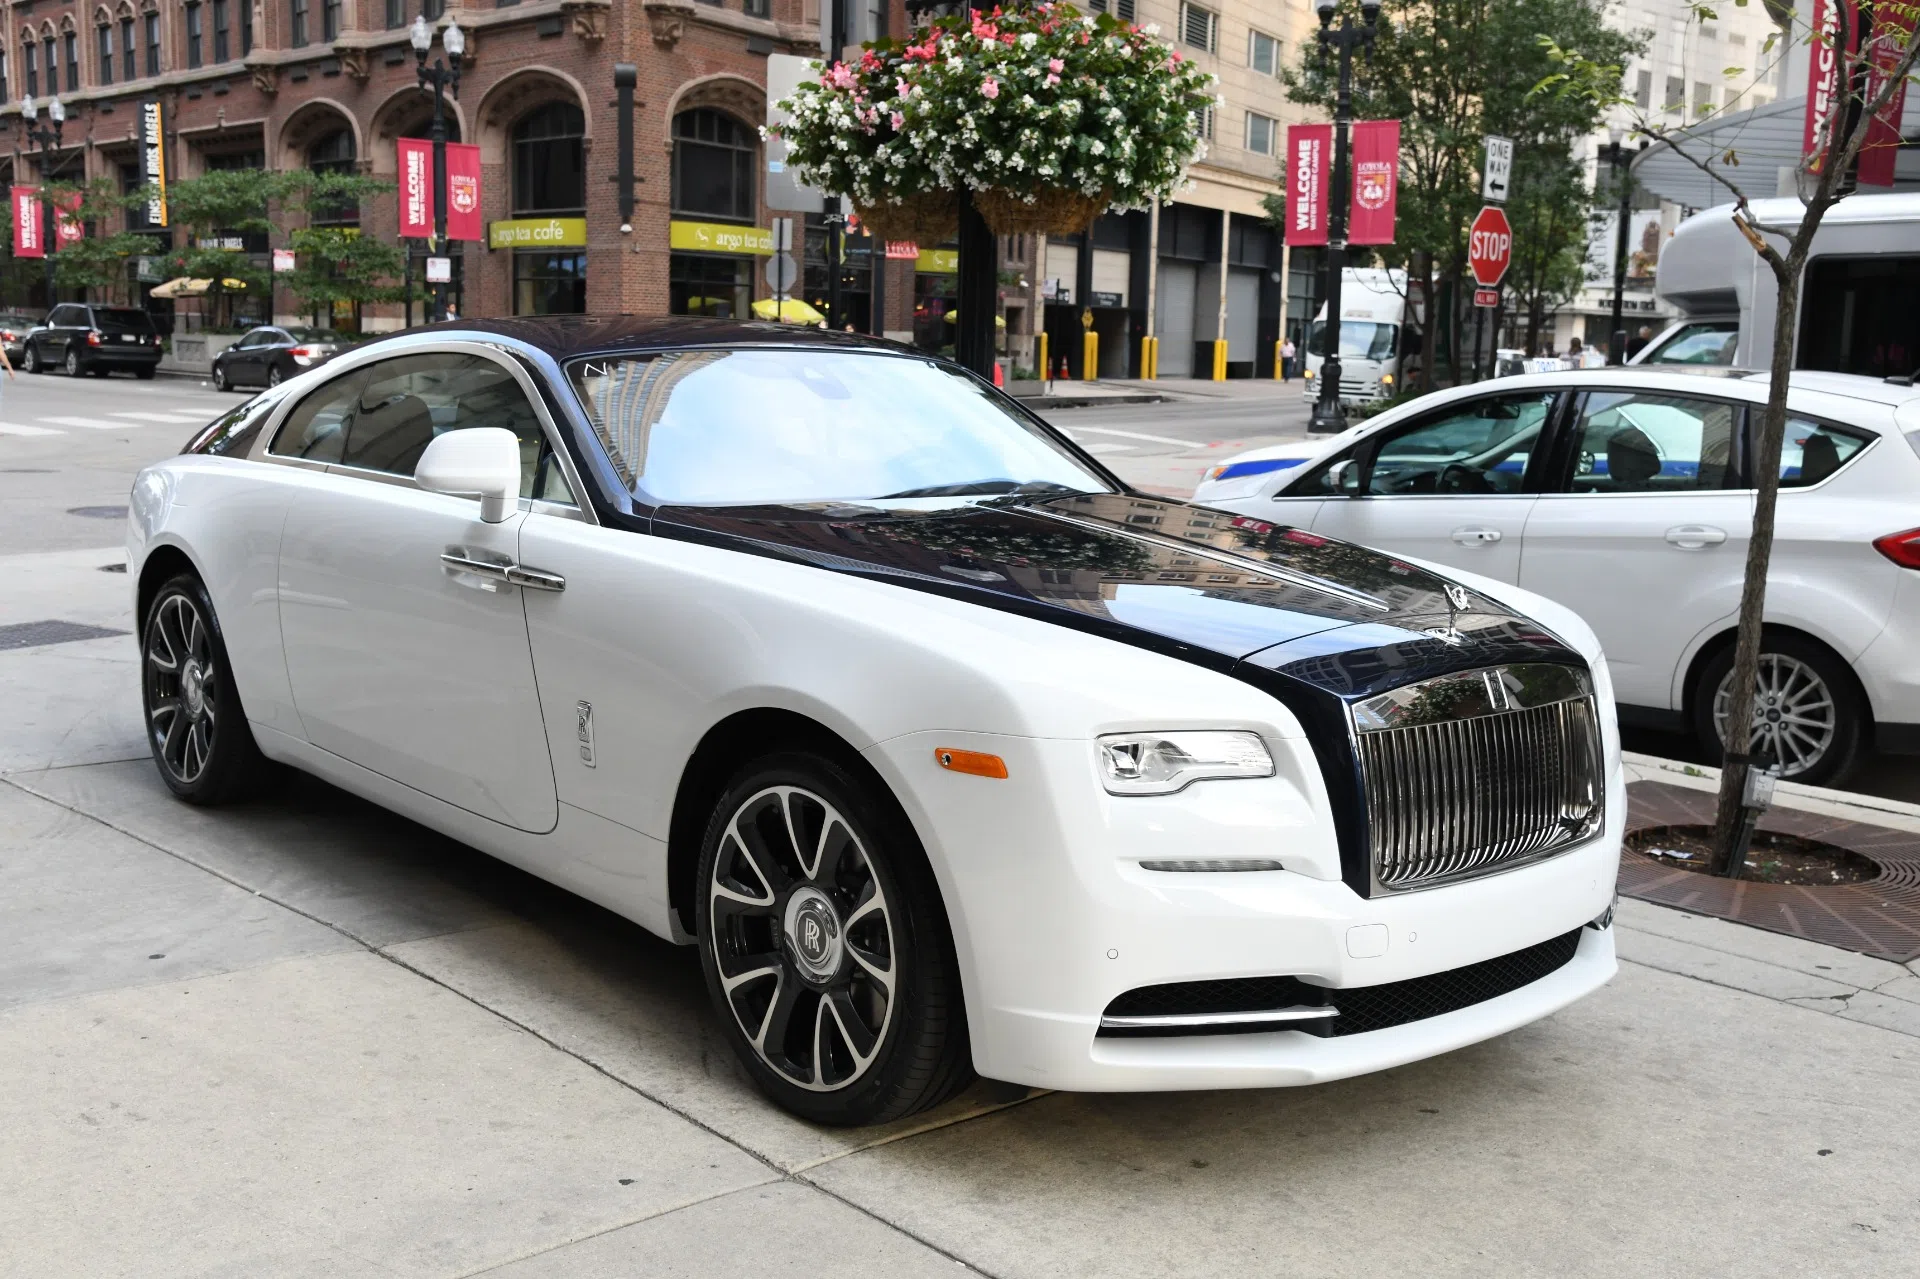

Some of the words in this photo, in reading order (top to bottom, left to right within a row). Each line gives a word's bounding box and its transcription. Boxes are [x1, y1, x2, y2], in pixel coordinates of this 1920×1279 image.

[144, 103, 158, 144] BAGELS
[1311, 140, 1320, 174] CAMPUS
[1490, 142, 1509, 160] ONE
[1357, 162, 1392, 172] LOYOLA
[1489, 160, 1508, 175] WAY
[407, 150, 420, 225] WELCOME
[1296, 139, 1312, 231] WELCOME
[1311, 174, 1319, 203] TOWER
[148, 177, 162, 224] EINSN
[515, 226, 531, 240] tea
[533, 220, 564, 240] café
[716, 233, 743, 251] argo
[744, 232, 758, 248] tea
[1472, 230, 1509, 262] STOP
[1476, 294, 1486, 303] ALL
[1486, 294, 1496, 303] WAY
[805, 917, 820, 953] RR
